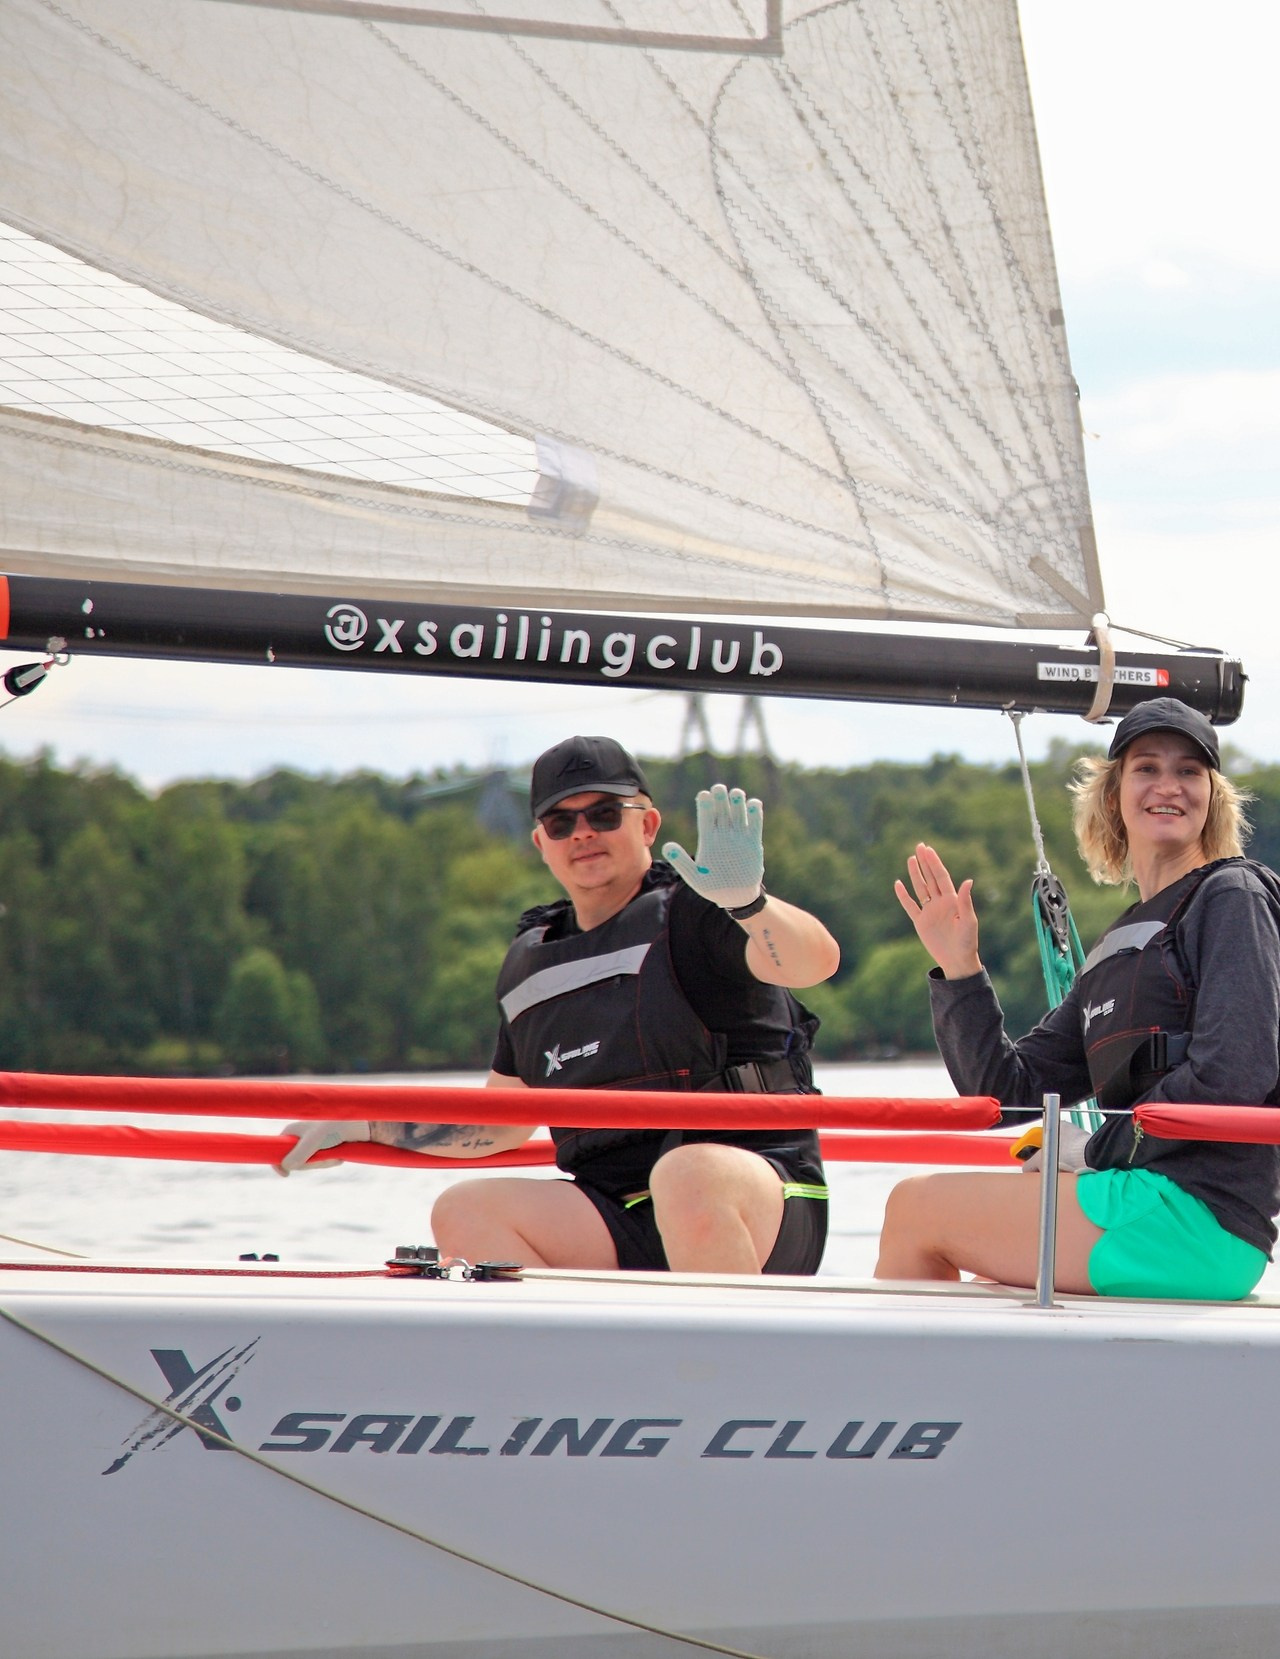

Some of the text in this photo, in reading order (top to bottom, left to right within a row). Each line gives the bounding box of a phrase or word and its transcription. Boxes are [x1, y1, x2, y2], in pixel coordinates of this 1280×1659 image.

[323, 603, 784, 677] @xsailingclub
[1045, 666, 1151, 682] WIND BTHERS
[258, 1412, 683, 1458] SAILING
[700, 1420, 963, 1459] CLUB
